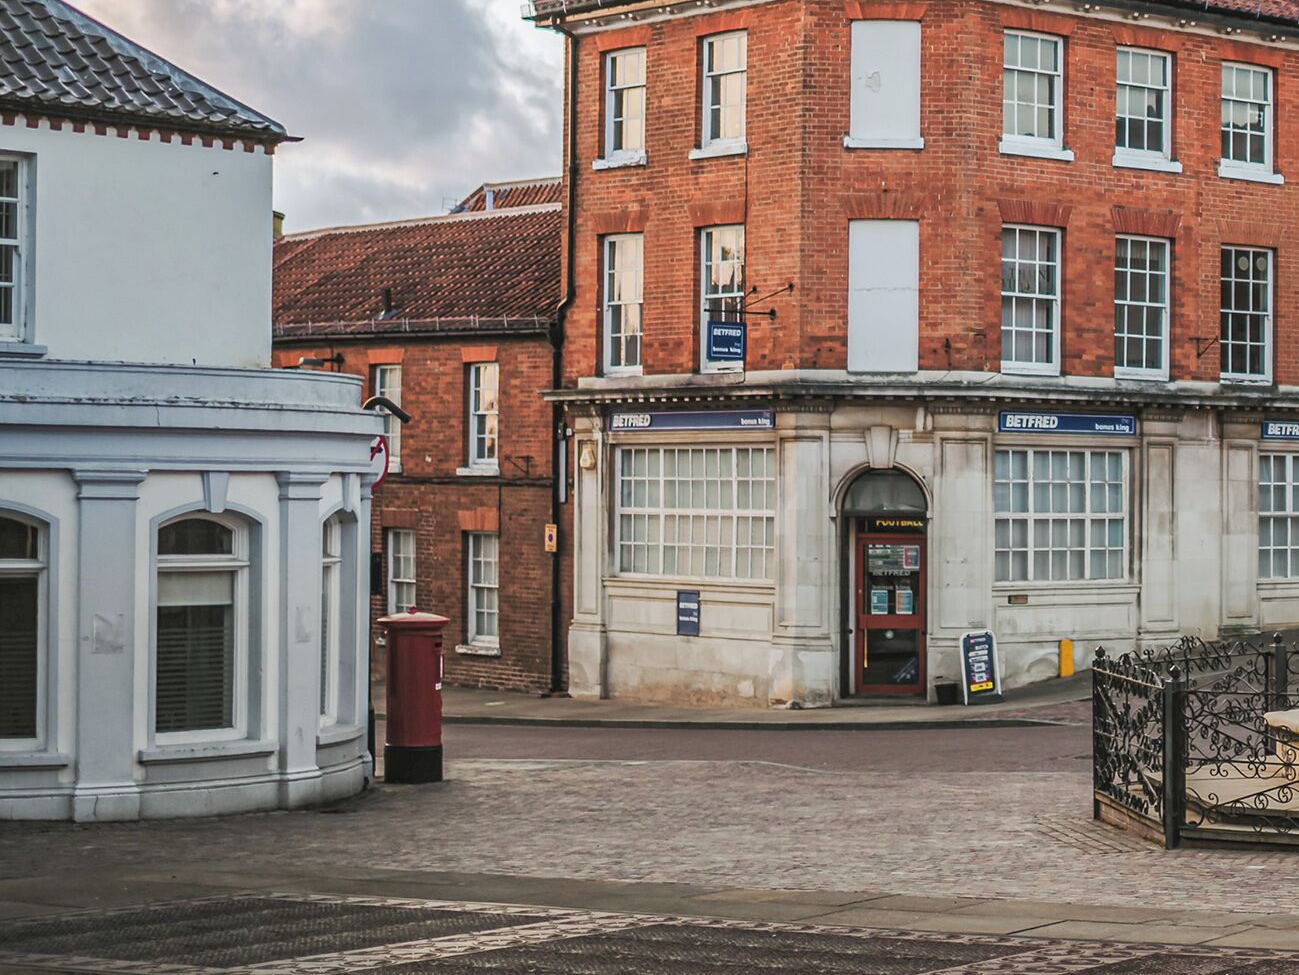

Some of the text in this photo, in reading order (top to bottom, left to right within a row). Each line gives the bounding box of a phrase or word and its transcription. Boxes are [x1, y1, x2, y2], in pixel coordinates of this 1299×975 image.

[612, 414, 651, 427] BETFRED
[1005, 415, 1058, 428] BETFRED
[1115, 424, 1129, 433] king
